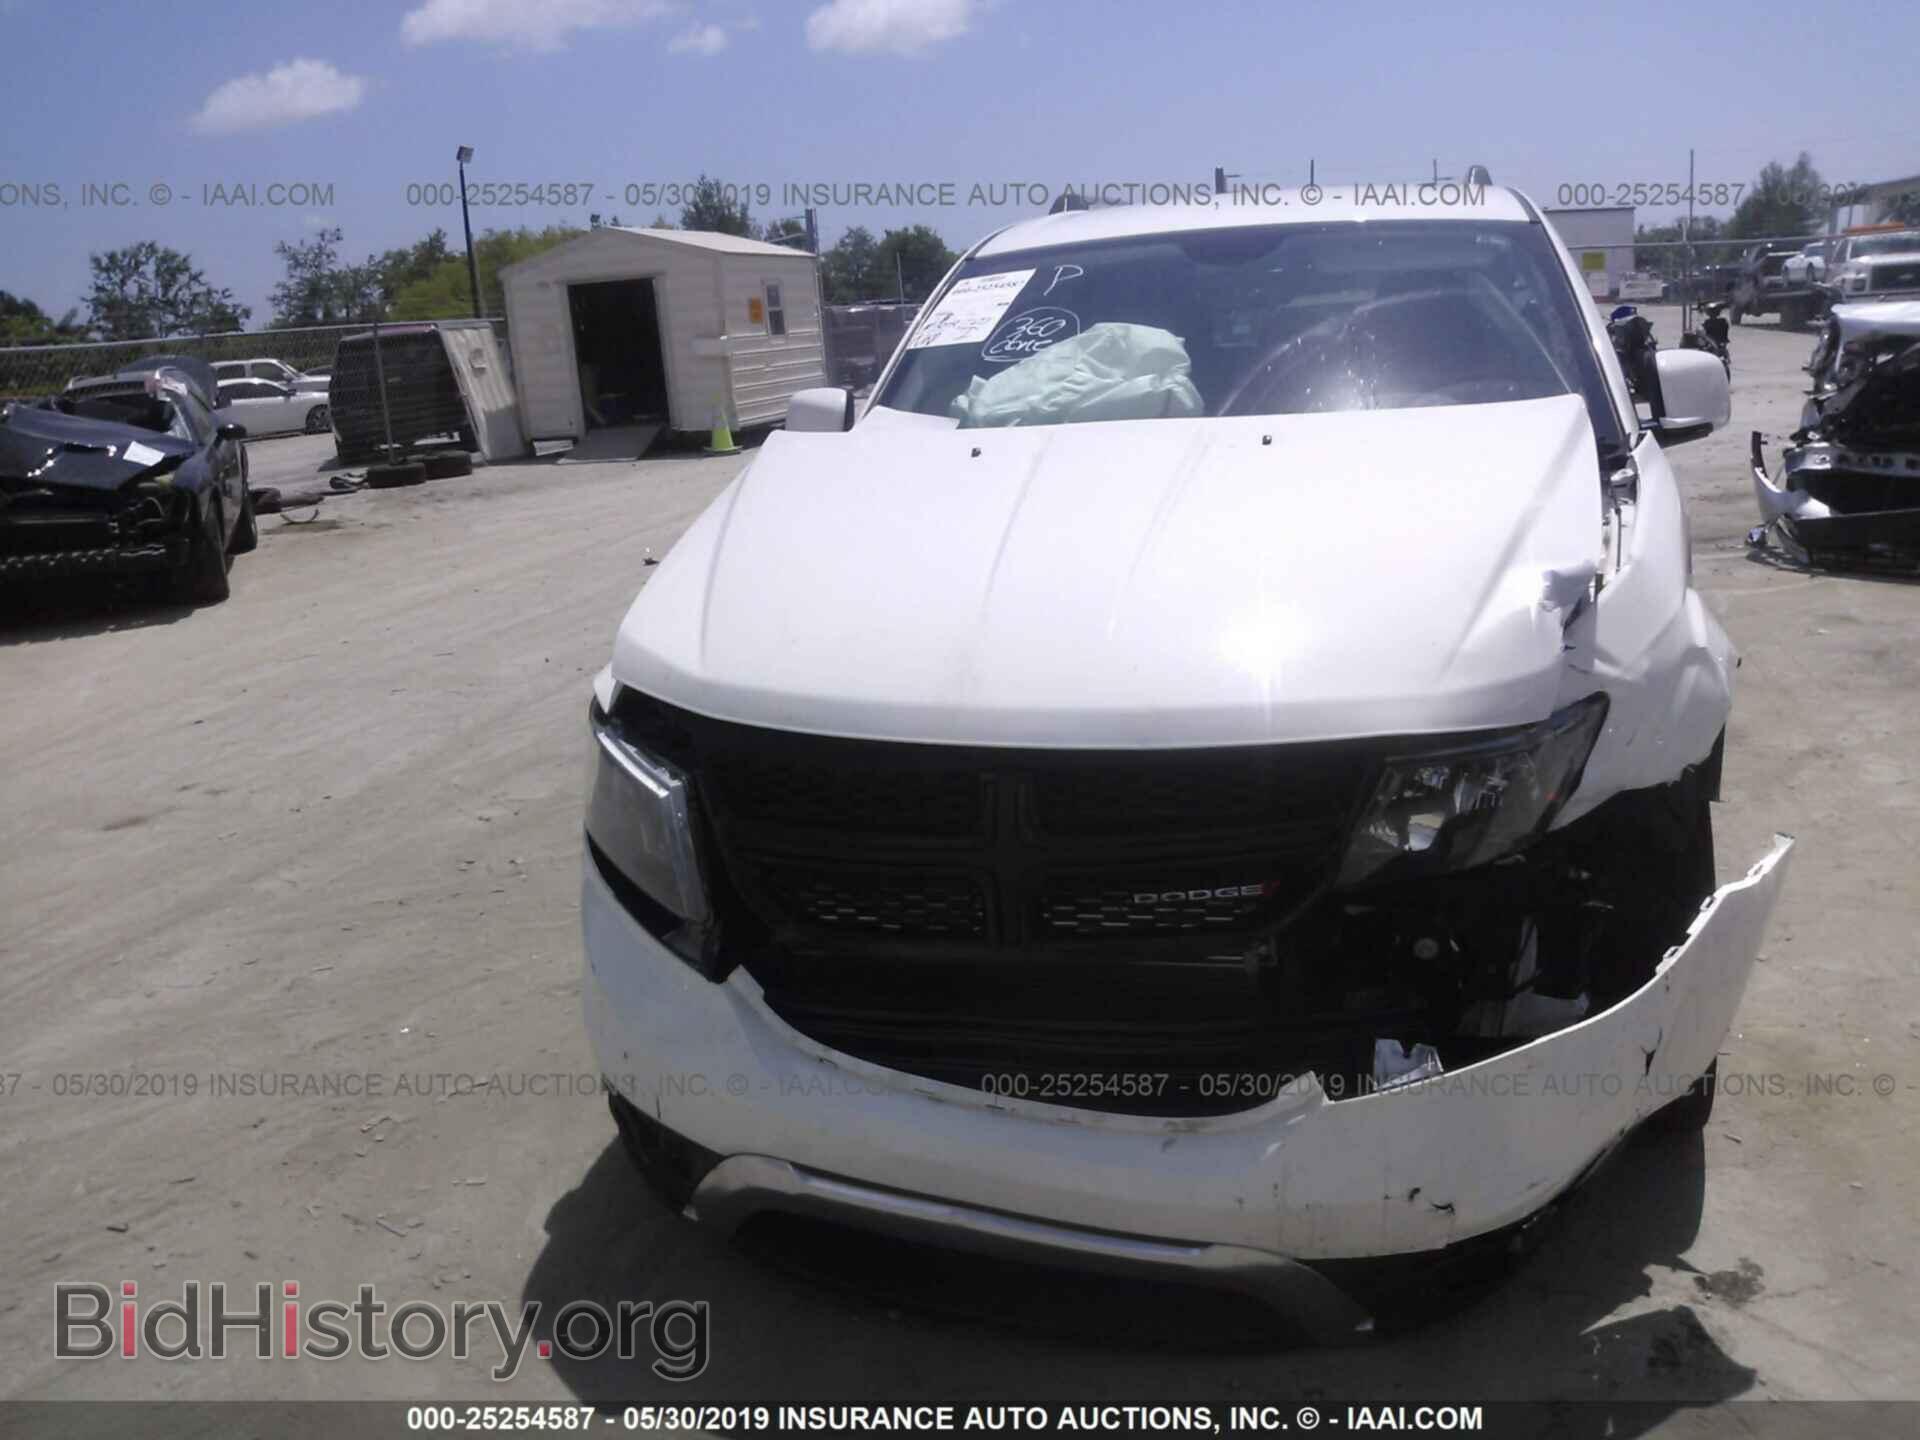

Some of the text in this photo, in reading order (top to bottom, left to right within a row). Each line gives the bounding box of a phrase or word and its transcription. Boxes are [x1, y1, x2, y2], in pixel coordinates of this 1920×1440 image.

[1043, 264, 1084, 296] P
[1005, 316, 1068, 340] 360
[1133, 883, 1265, 904] DODGE
